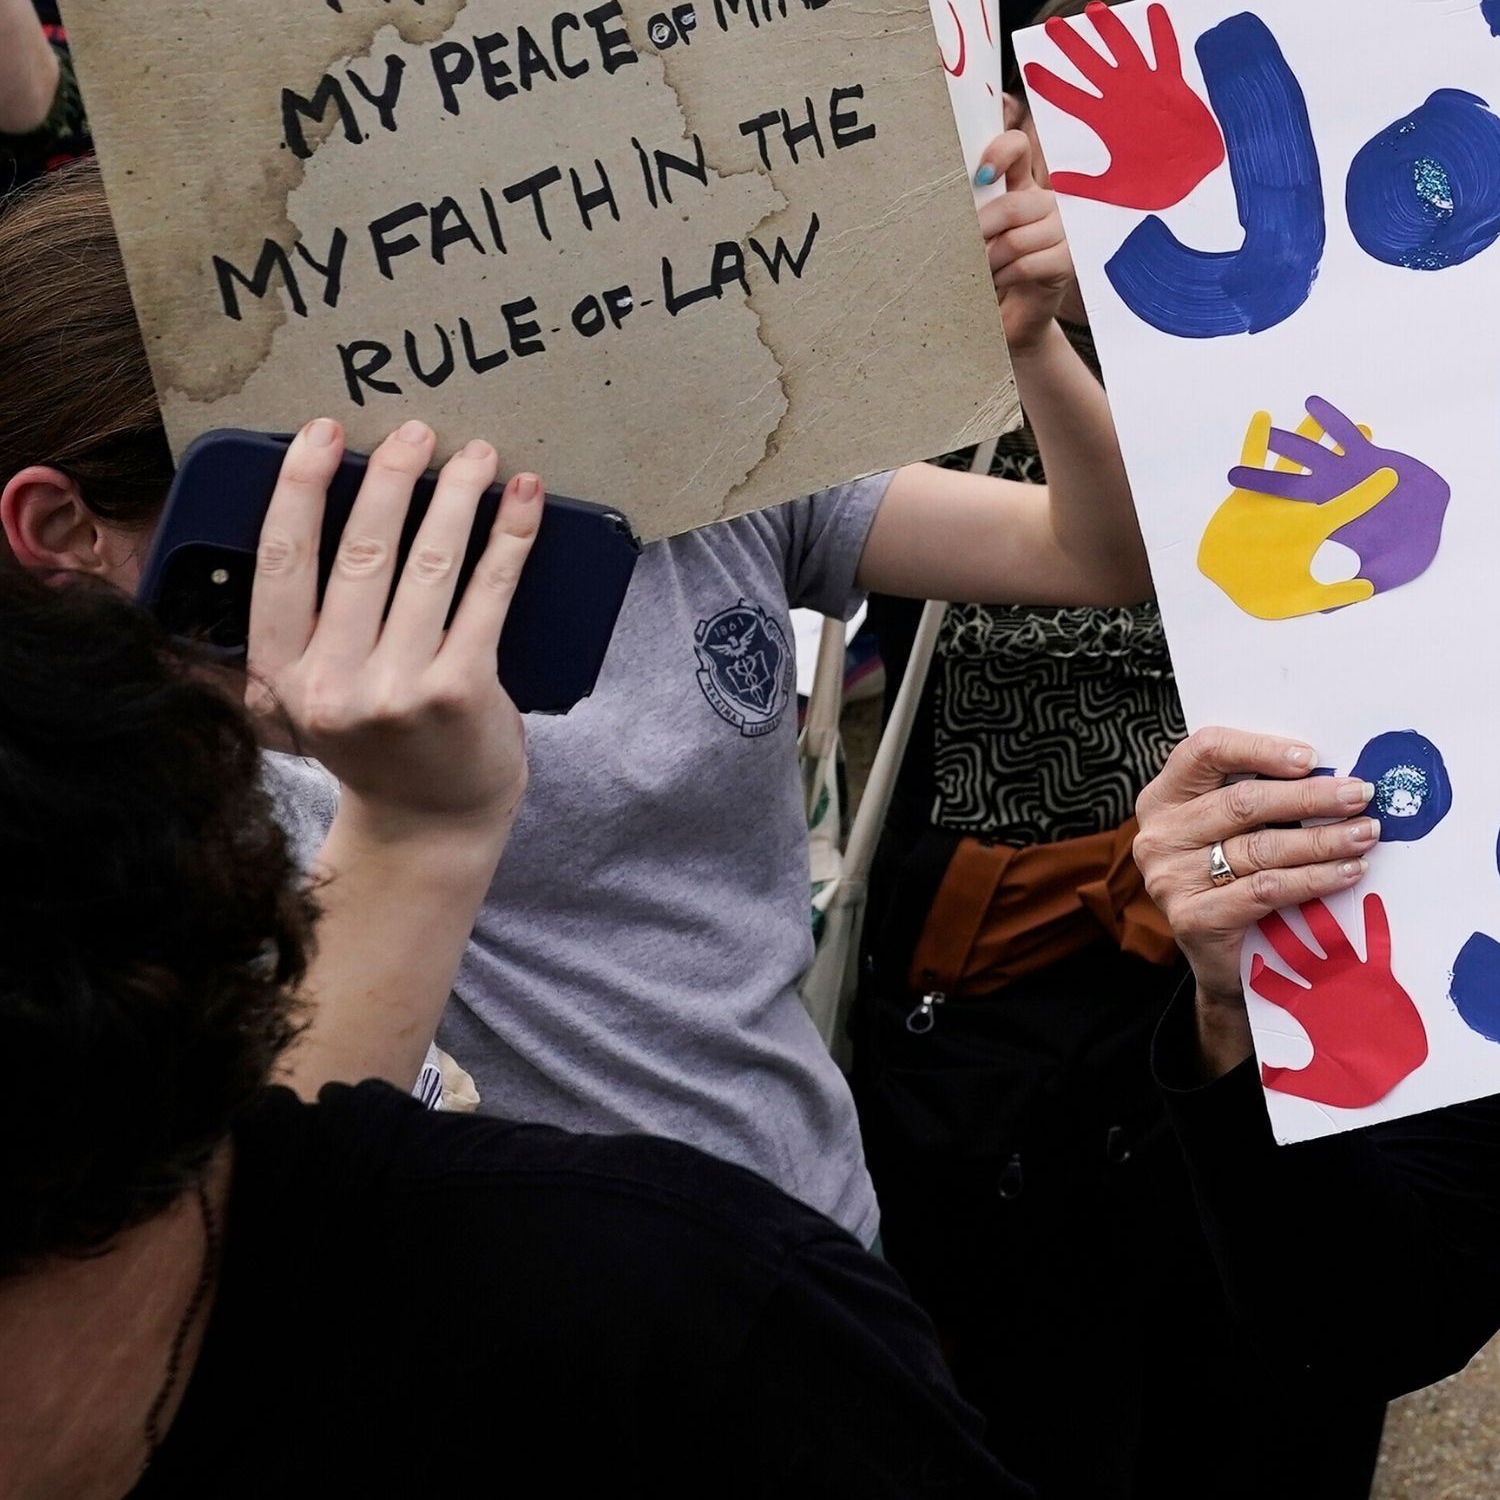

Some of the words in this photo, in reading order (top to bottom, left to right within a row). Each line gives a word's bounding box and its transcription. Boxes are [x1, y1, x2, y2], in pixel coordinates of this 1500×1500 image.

[281, 54, 405, 159] MY
[430, 0, 639, 115] PEACE
[212, 228, 348, 321] MY
[367, 158, 625, 280] FAITH
[630, 136, 708, 210] IN
[740, 83, 877, 172] THE
